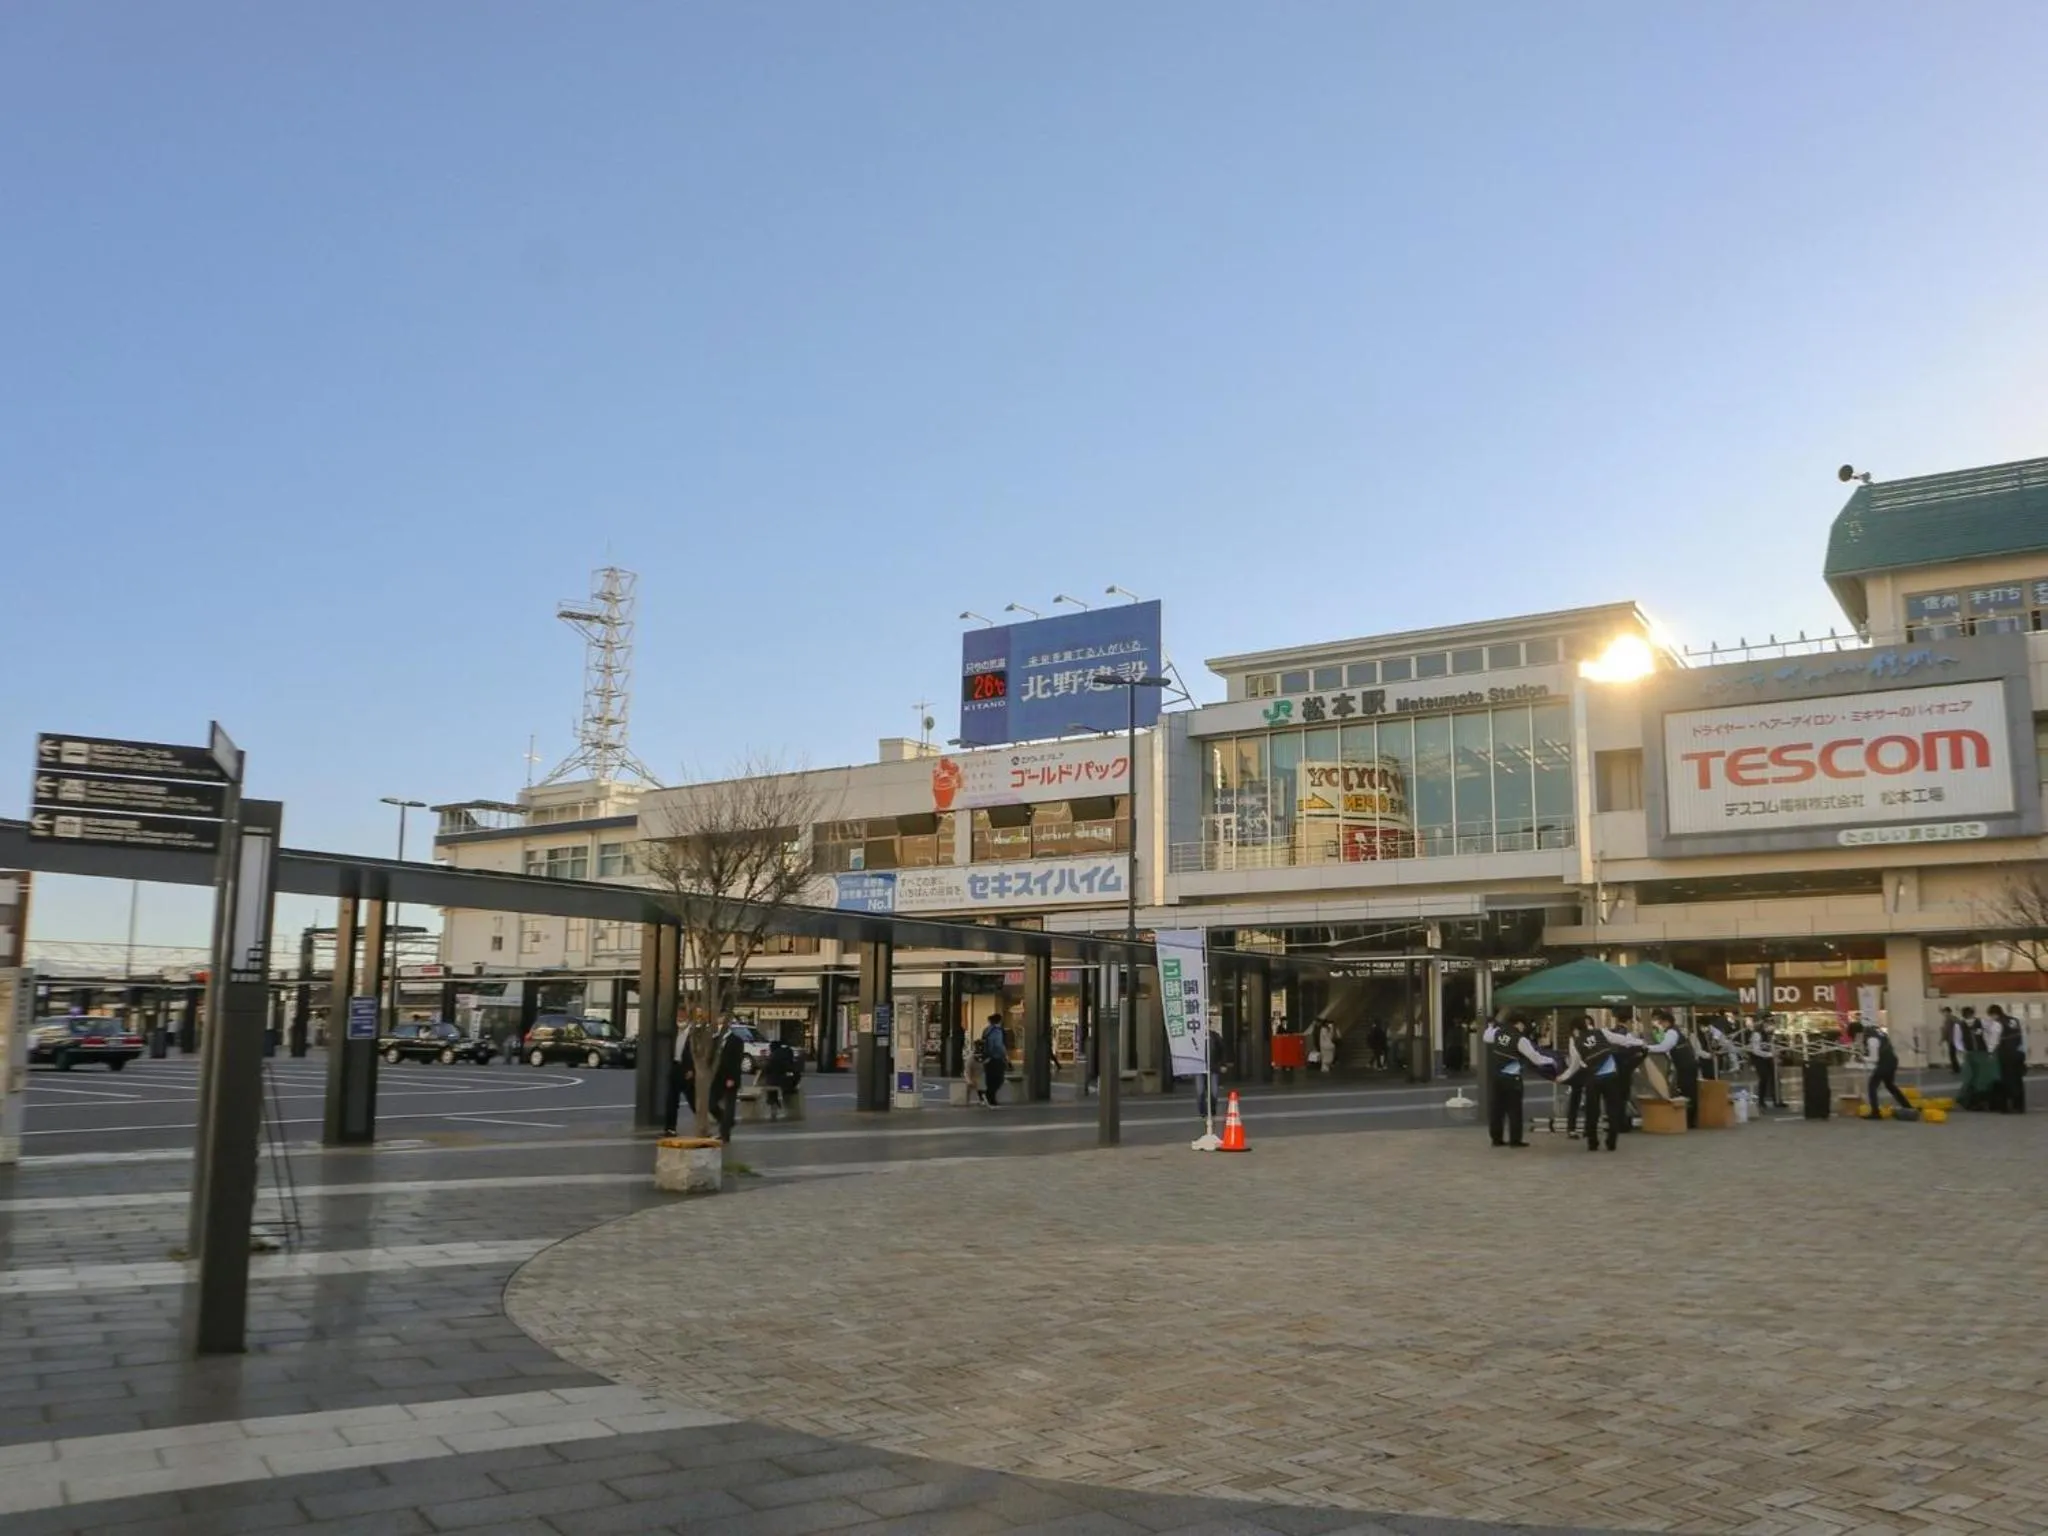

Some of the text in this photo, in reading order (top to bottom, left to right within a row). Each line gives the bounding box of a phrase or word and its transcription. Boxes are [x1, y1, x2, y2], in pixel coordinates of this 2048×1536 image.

[963, 701, 1006, 711] KITANO
[1262, 699, 1293, 723] JR
[1302, 690, 1386, 721] 松本駅
[1396, 684, 1549, 712] Matsumoto Station
[1010, 757, 1128, 788] ゴールドパック
[1682, 729, 1991, 790] TESCOM
[1880, 786, 1945, 806] 松本工場
[967, 865, 1122, 900] セキスイハイム
[867, 888, 893, 911] No.1
[1738, 984, 1836, 1004] MDORI
